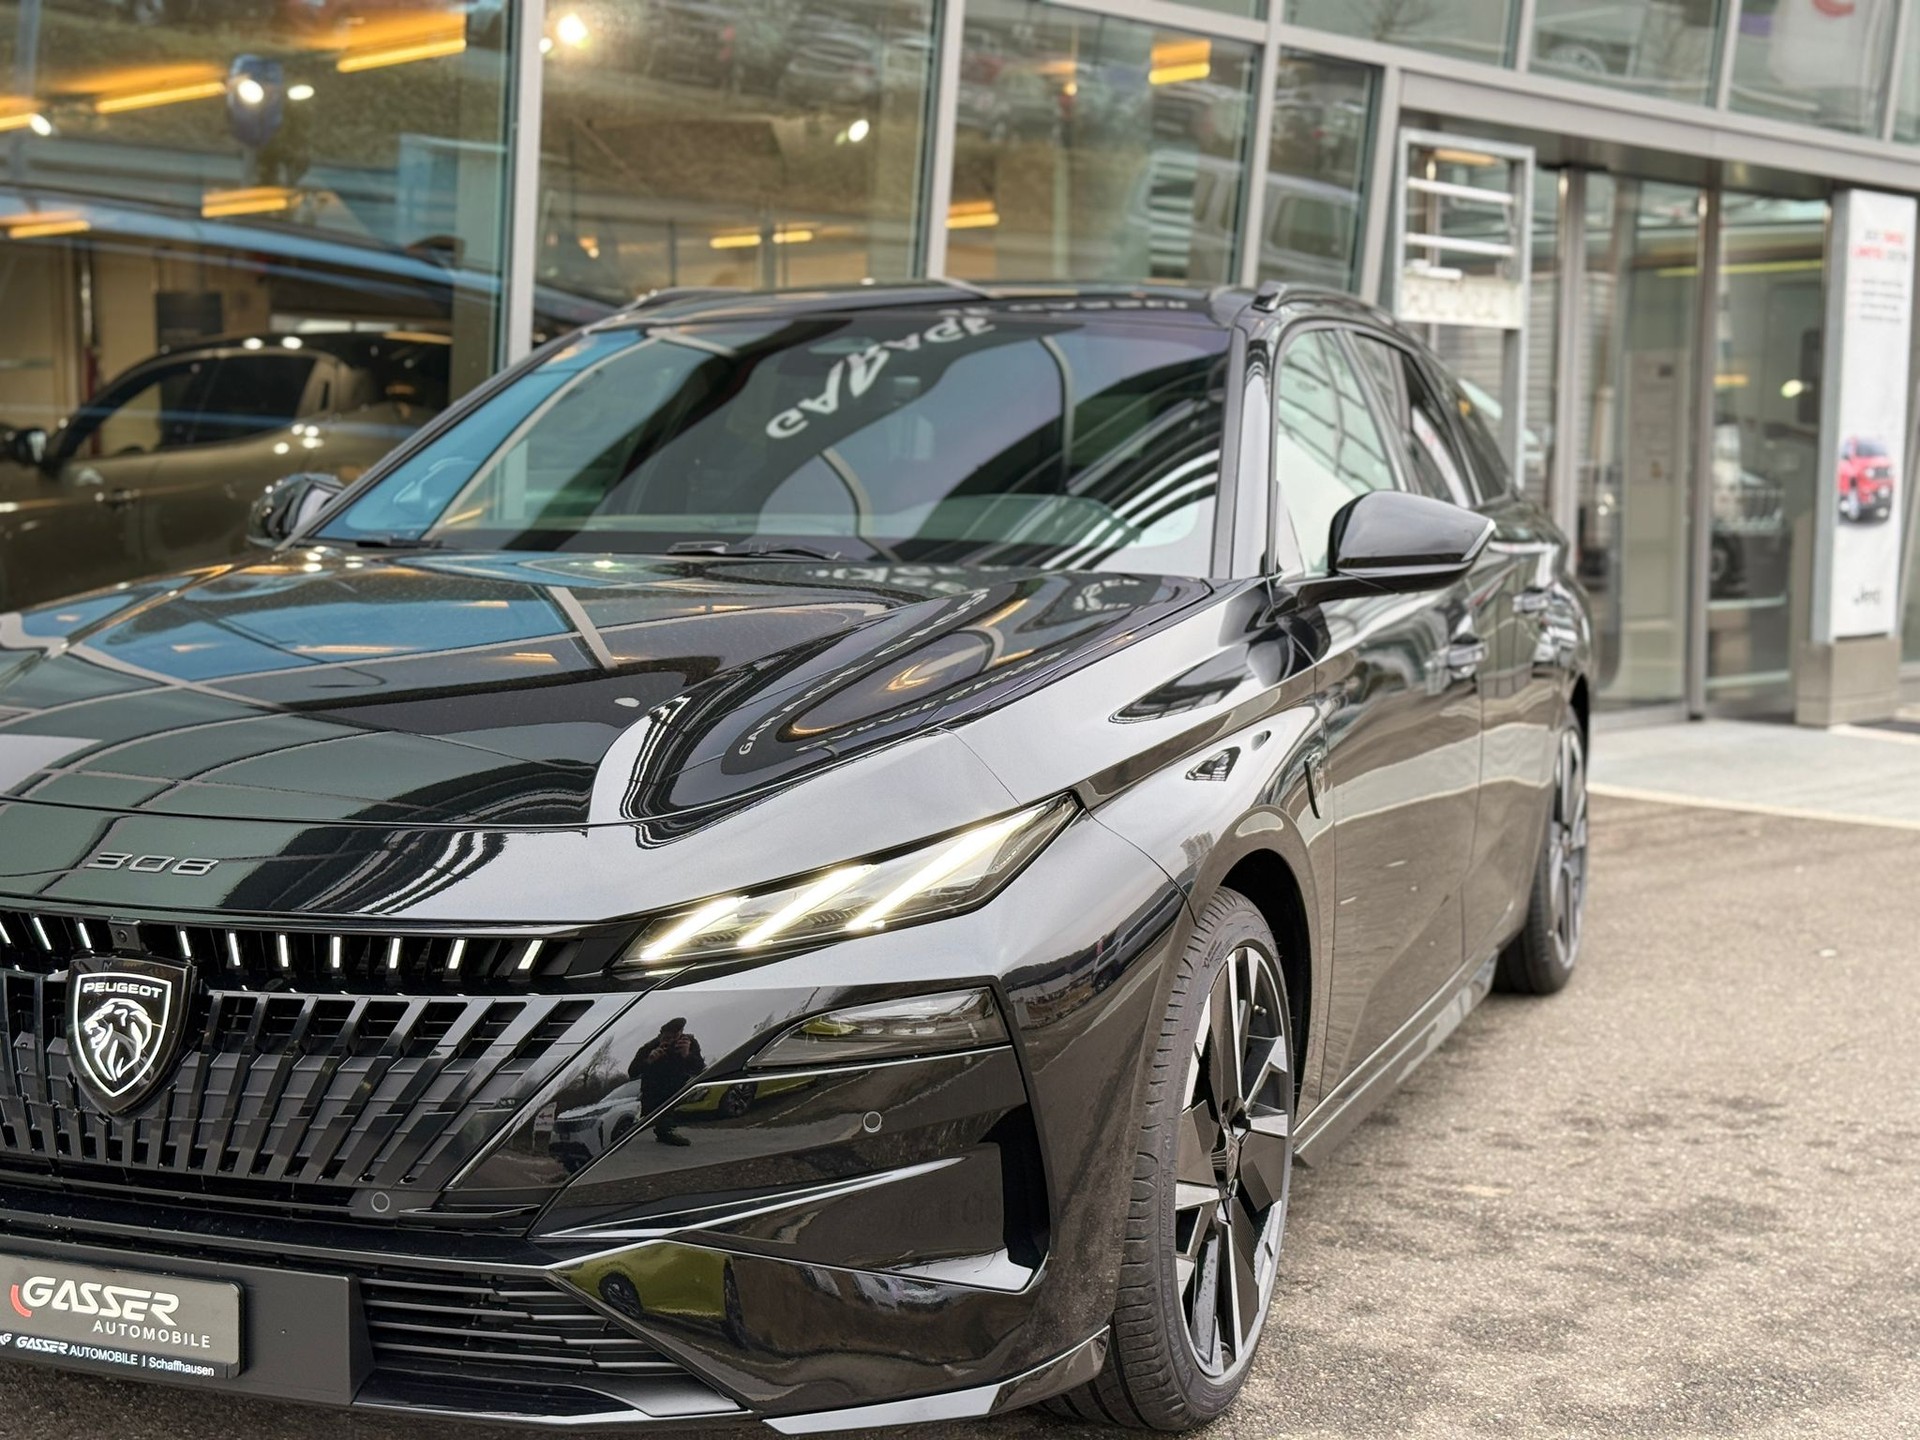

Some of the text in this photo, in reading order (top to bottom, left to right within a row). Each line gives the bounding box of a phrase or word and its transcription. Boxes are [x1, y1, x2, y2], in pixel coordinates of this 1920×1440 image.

[84, 851, 220, 876] 308
[82, 982, 163, 998] PEUGEOT
[22, 1276, 179, 1326] GASSER
[93, 1320, 210, 1348] AUTOMOBILE
[16, 1336, 68, 1354] GASSER
[69, 1345, 138, 1365] AUTOMOBILE
[149, 1357, 214, 1376] Schaffhausen
